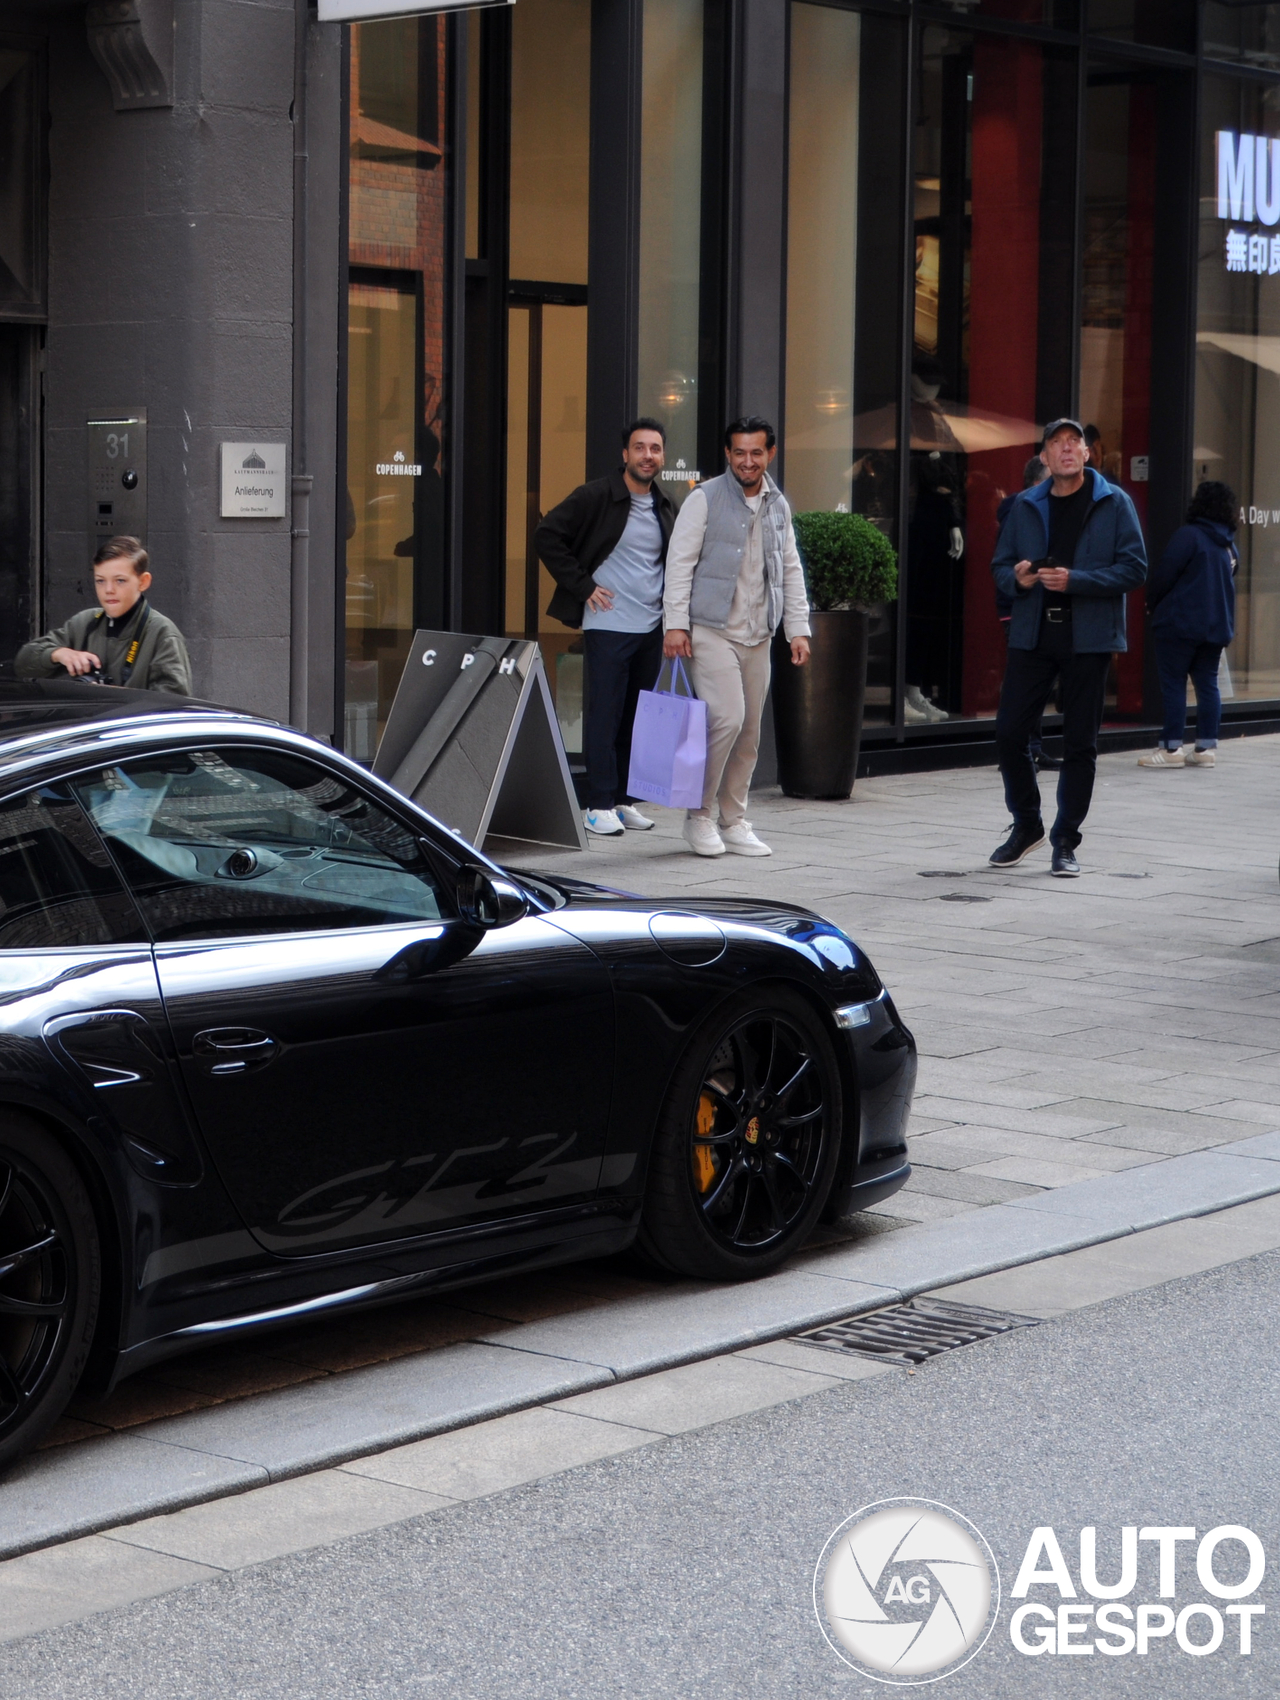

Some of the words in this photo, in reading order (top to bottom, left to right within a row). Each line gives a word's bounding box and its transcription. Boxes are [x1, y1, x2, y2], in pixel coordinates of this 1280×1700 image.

[106, 433, 129, 459] 31
[376, 463, 422, 476] COPENHAGEN
[661, 470, 701, 481] COPENHAGEN
[234, 485, 274, 499] Anlieferung
[1239, 506, 1246, 525] A
[1249, 505, 1270, 528] Day
[126, 641, 139, 664] Nikon
[633, 780, 666, 797] STUDIOS
[259, 1130, 578, 1237] GT2
